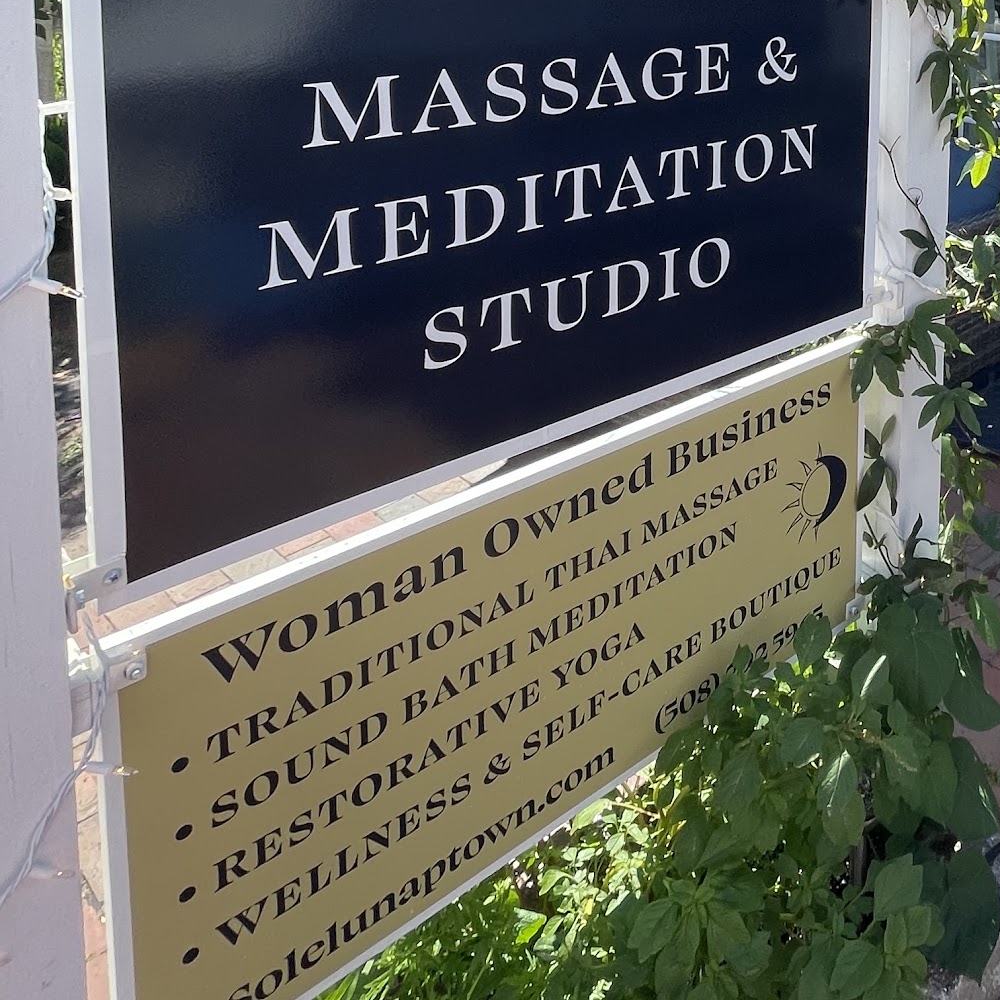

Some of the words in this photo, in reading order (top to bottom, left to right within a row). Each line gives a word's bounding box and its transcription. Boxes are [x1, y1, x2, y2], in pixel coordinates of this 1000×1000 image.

[257, 123, 818, 291] MEDITATION
[302, 41, 731, 150] MASSAGE
[757, 36, 799, 86] &
[422, 237, 732, 371] STUDIO
[200, 543, 467, 685] Woman
[483, 453, 653, 558] Owned
[667, 383, 833, 479] Business
[205, 583, 535, 765] TRADITIONAL
[544, 531, 633, 592] THAI
[640, 457, 780, 544] MASSAGE
[210, 711, 389, 829] SOUND
[401, 645, 518, 727] BATH
[527, 521, 740, 655] MEDITATION
[212, 681, 541, 893] RESTORATIVE
[549, 621, 647, 691] YOGA
[213, 775, 472, 947] WELLNESS
[482, 752, 513, 796] &
[521, 631, 703, 763] SELF-CARE
[709, 546, 843, 645] BOUTIQUE
